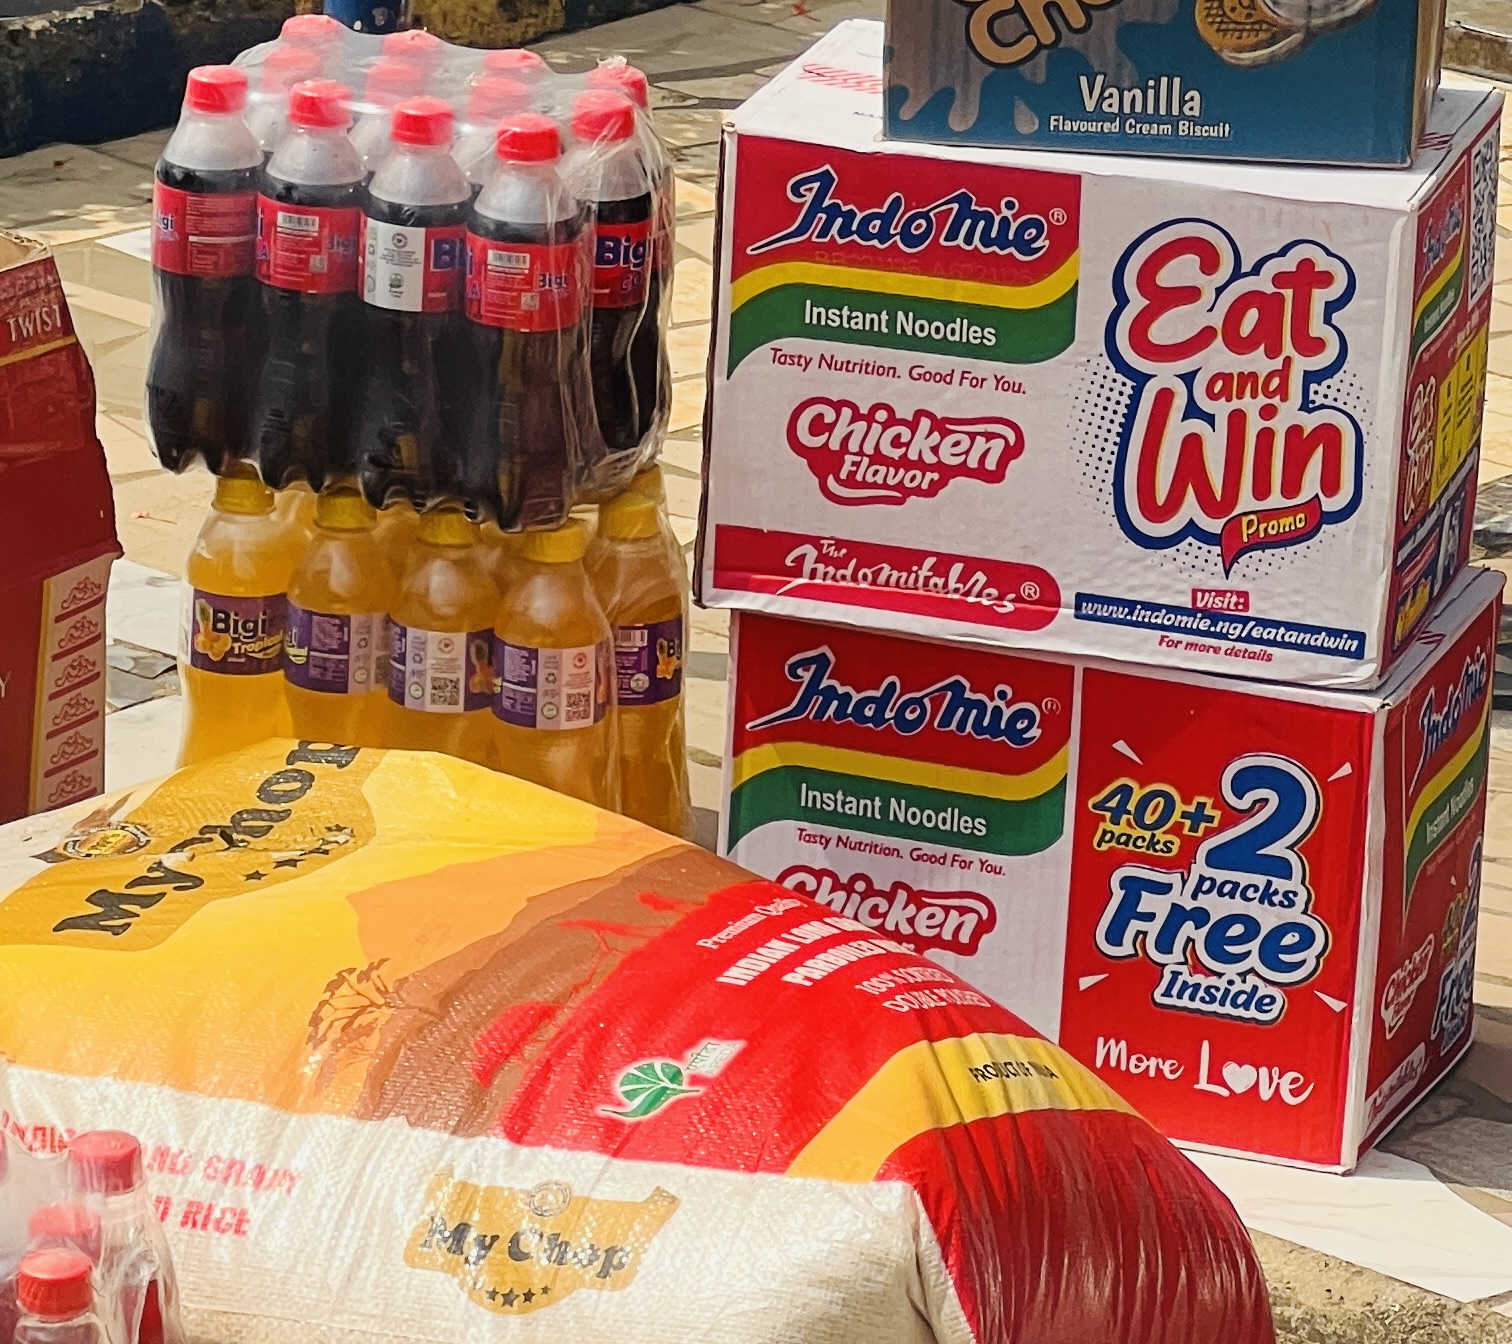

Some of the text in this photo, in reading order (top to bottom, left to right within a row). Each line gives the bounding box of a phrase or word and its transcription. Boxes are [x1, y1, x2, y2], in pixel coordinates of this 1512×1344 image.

[1079, 74, 1202, 117] Vanilla
[1050, 116, 1230, 138] Flavoured Cream Biscuit
[593, 235, 651, 271] Big
[1128, 236, 1336, 364] Eat
[7, 305, 62, 342] TWIST
[804, 299, 998, 347] Instant Noodles
[770, 347, 1026, 396] Tasty Nutrition. Good For You.
[1205, 356, 1292, 404] and
[794, 402, 1014, 472] Chicken
[1136, 386, 1344, 523] Win
[839, 455, 940, 491] Flavor
[1241, 509, 1306, 543] Promo
[820, 539, 848, 558] The
[777, 541, 1017, 614] Indomitables
[1195, 591, 1246, 611] Visit:
[212, 607, 268, 642] Bigi
[1080, 599, 1359, 653] www.indomie.ng/eatandwin
[1157, 634, 1273, 663] For more details
[801, 783, 987, 837] Instant Noodles
[796, 828, 1006, 877] Tasty Nutrition. Good For You.
[1097, 828, 1176, 855] packs
[1191, 872, 1298, 908] packs
[696, 912, 768, 949] Premium
[1104, 874, 1317, 973] Free
[716, 938, 801, 986] INDIAN
[1161, 971, 1276, 1014] Inside
[1094, 1036, 1184, 1081] More
[180, 1200, 252, 1237] RICE
[420, 1215, 628, 1279] My Chop
